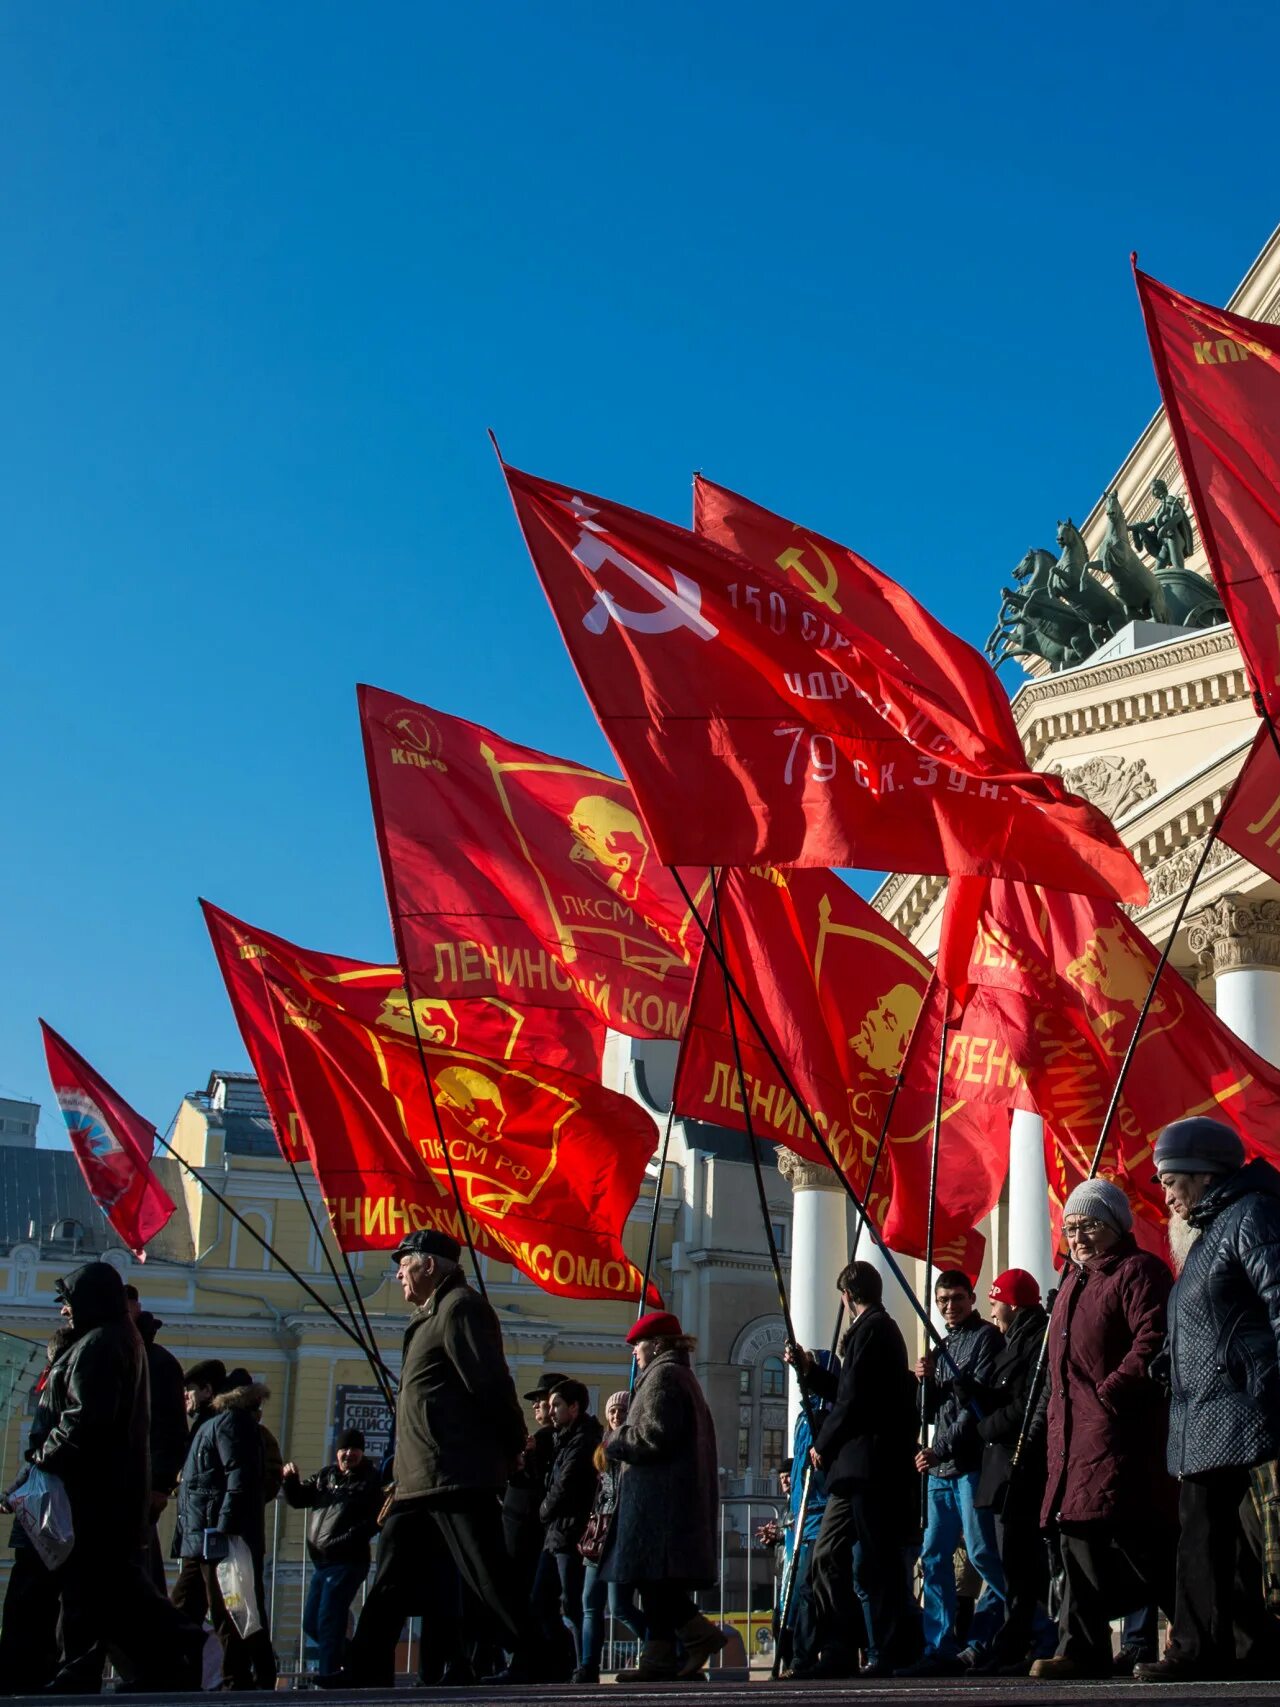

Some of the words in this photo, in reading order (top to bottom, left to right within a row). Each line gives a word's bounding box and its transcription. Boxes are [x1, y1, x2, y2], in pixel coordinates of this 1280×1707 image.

[727, 583, 787, 635] 150
[773, 728, 837, 785] 79
[562, 895, 634, 926] ЛКСМ
[420, 1139, 488, 1165] ЛКСМ
[498, 1154, 532, 1181] РФ
